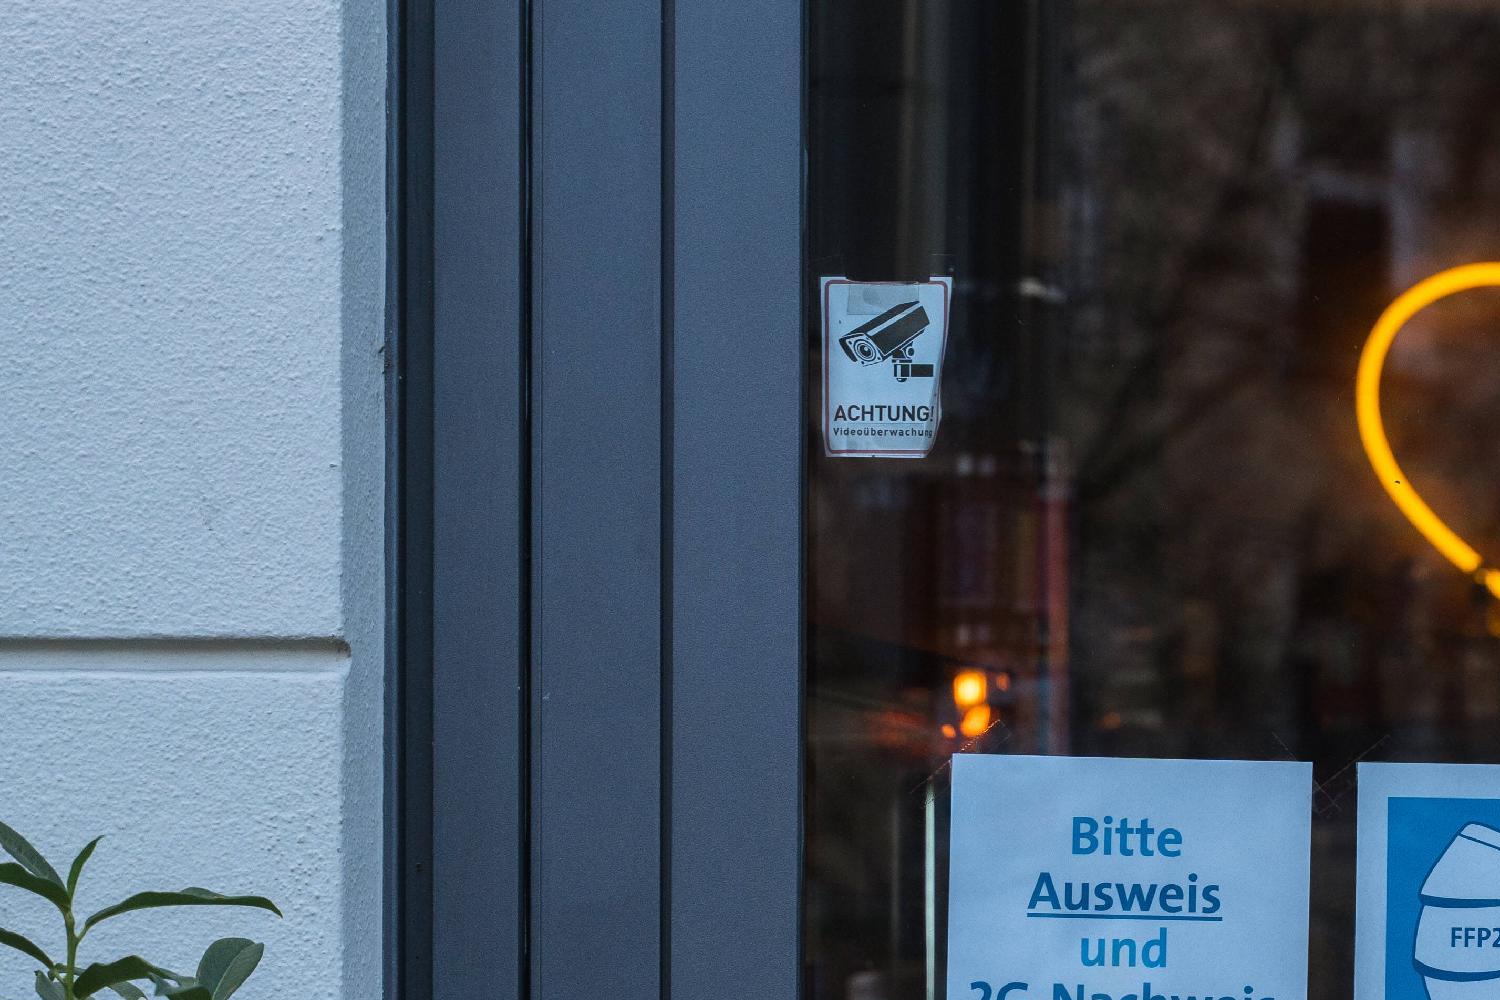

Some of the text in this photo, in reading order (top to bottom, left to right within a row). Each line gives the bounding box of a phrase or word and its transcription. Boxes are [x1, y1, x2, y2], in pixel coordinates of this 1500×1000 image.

[833, 428, 933, 438] Videoüberwachung
[834, 405, 935, 421] ACHTUNG!
[1072, 816, 1182, 857] Bitte
[1028, 872, 1220, 914] Ausweis
[1081, 927, 1167, 968] und
